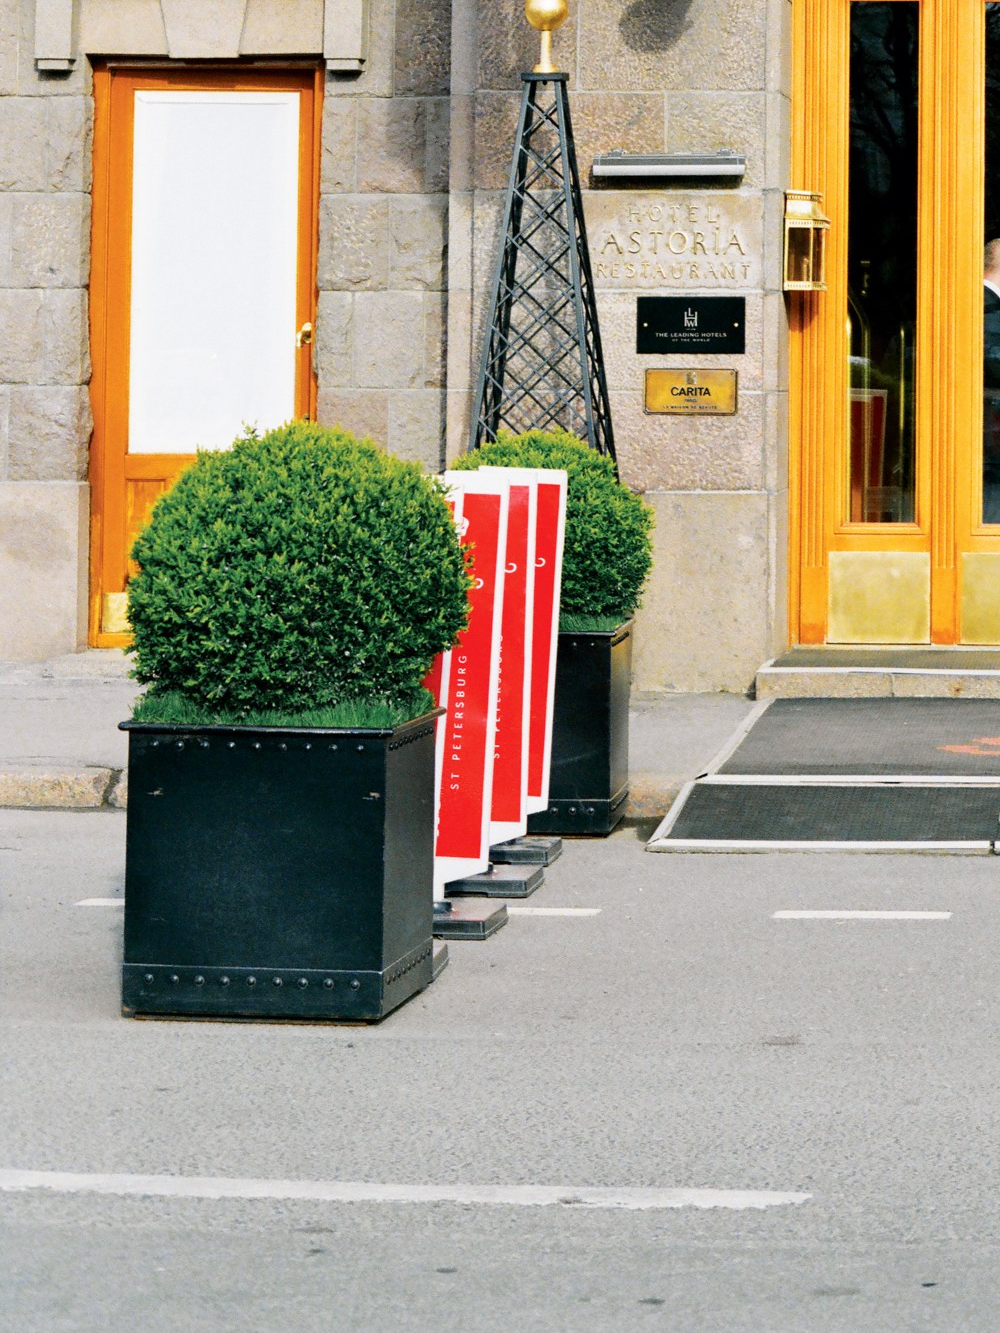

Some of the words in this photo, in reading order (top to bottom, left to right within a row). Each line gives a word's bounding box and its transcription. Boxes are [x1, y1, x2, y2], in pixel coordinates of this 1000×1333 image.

[628, 205, 718, 223] HOTEL
[600, 229, 745, 255] ASTORIA
[594, 263, 750, 279] RESTAURANT
[670, 386, 711, 397] CARITA
[452, 654, 467, 761] PETERSBURG
[450, 772, 460, 790] ST
